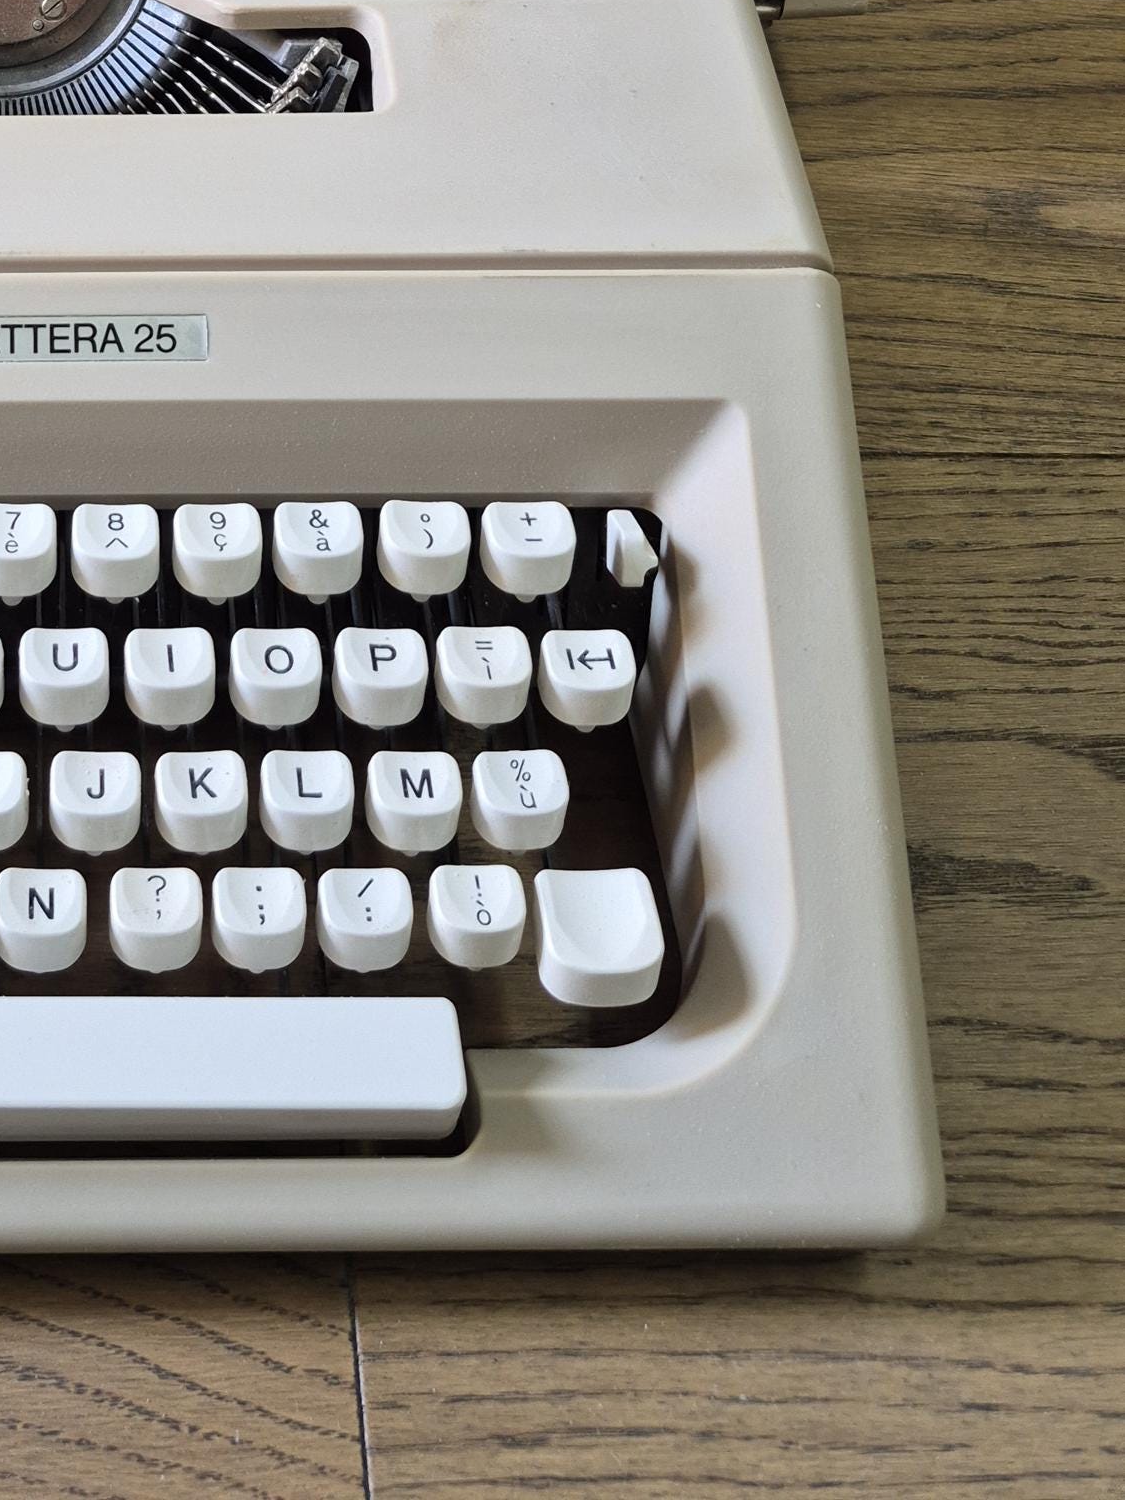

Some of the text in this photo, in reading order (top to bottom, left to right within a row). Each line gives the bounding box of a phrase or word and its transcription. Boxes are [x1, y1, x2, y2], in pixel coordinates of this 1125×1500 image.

[134, 323, 177, 354] 25
[5, 511, 21, 530] 7
[107, 512, 125, 532] 8
[209, 511, 227, 530] 9
[308, 509, 330, 529] &
[520, 512, 537, 527] +
[4, 532, 19, 554] è
[105, 537, 129, 549] ^
[213, 533, 228, 552] ç
[316, 530, 332, 552] à
[423, 528, 434, 549] )
[474, 640, 494, 651] =
[52, 643, 79, 672] U
[166, 644, 175, 673] I
[264, 644, 294, 675] O
[368, 643, 397, 672] P
[481, 656, 492, 681] ì
[86, 768, 105, 800] J
[188, 767, 218, 799] K
[296, 767, 323, 799] L
[399, 768, 434, 799] M
[509, 759, 532, 782] %
[519, 783, 537, 809] ù
[147, 875, 167, 902] ?
[357, 878, 374, 898] /
[474, 875, 482, 897] !
[28, 887, 55, 920] N
[258, 904, 266, 926] ;
[365, 906, 373, 922] :
[476, 900, 492, 926] ò
